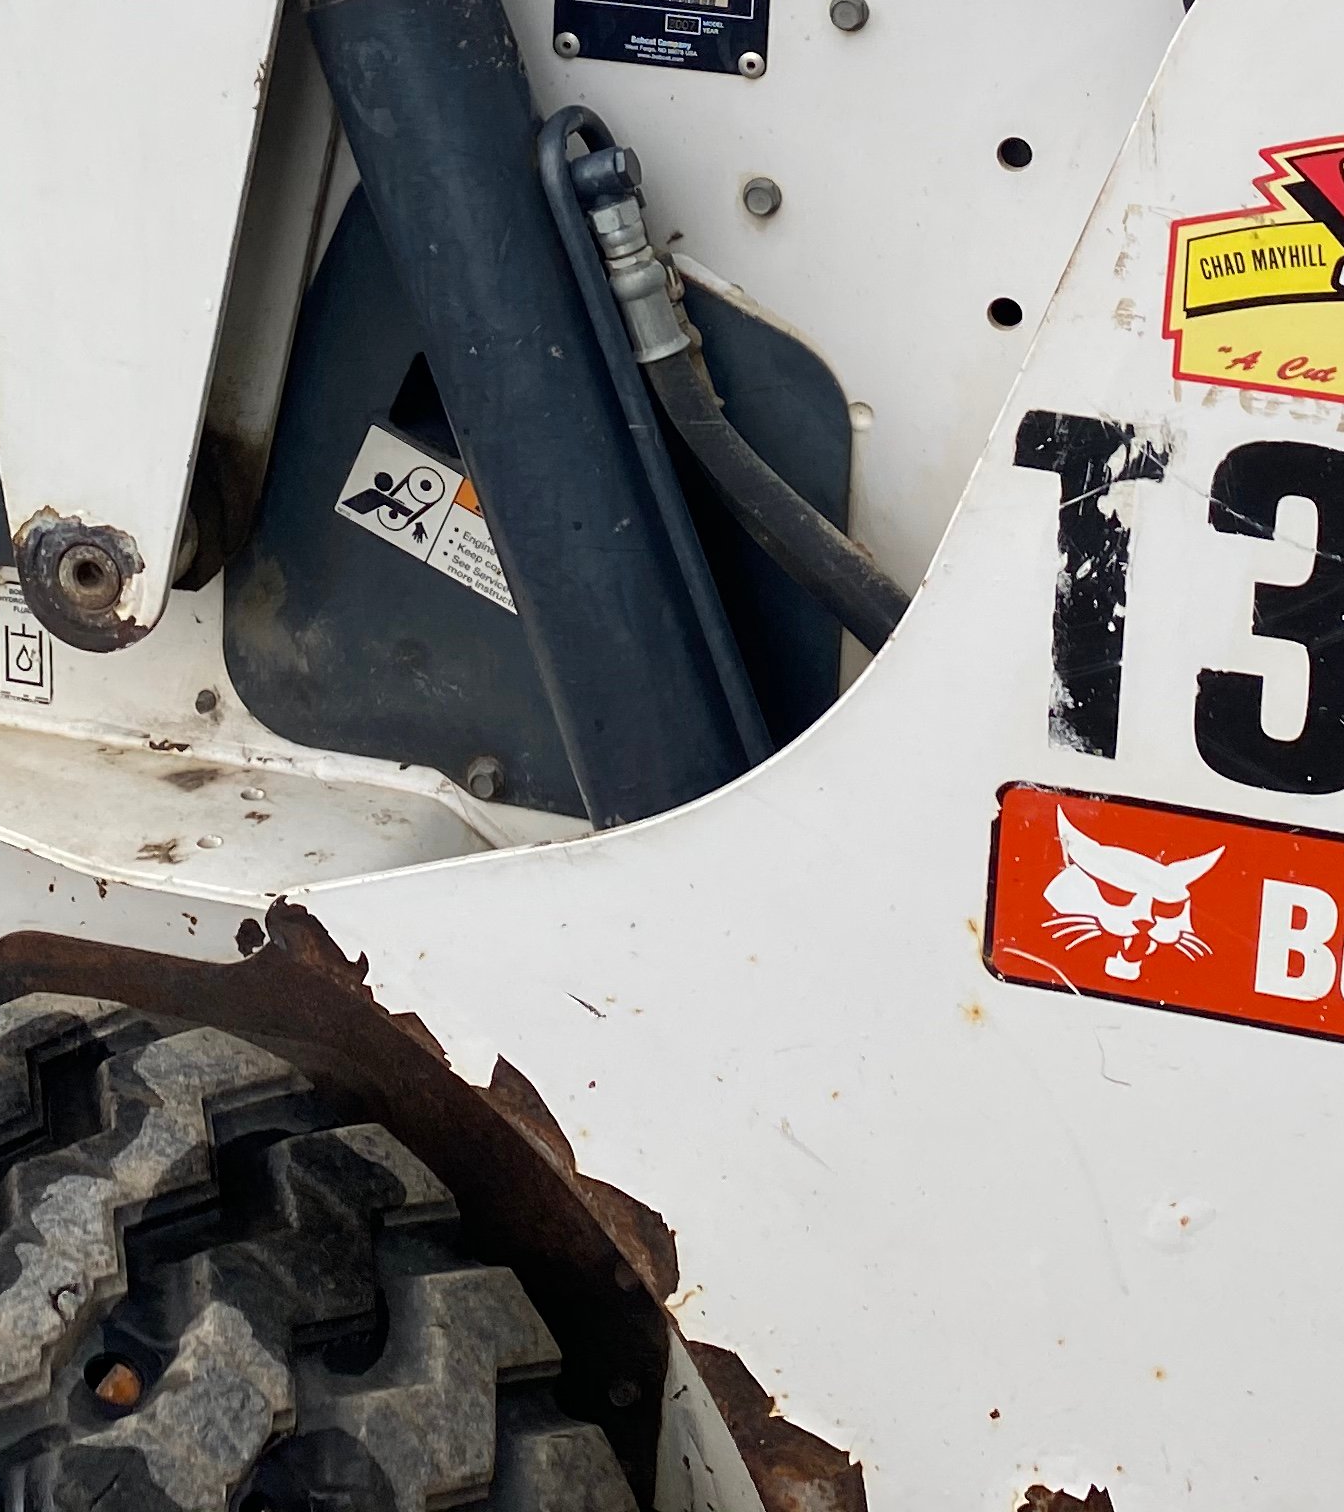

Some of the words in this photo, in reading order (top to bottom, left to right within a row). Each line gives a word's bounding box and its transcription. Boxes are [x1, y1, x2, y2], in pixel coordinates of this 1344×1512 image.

[1200, 252, 1246, 280] CHAD
[1252, 243, 1327, 271] MAYHILL
[1276, 356, 1338, 383] Cut
[451, 554, 471, 571] See
[457, 543, 483, 564] Keep
[447, 565, 473, 583] more
